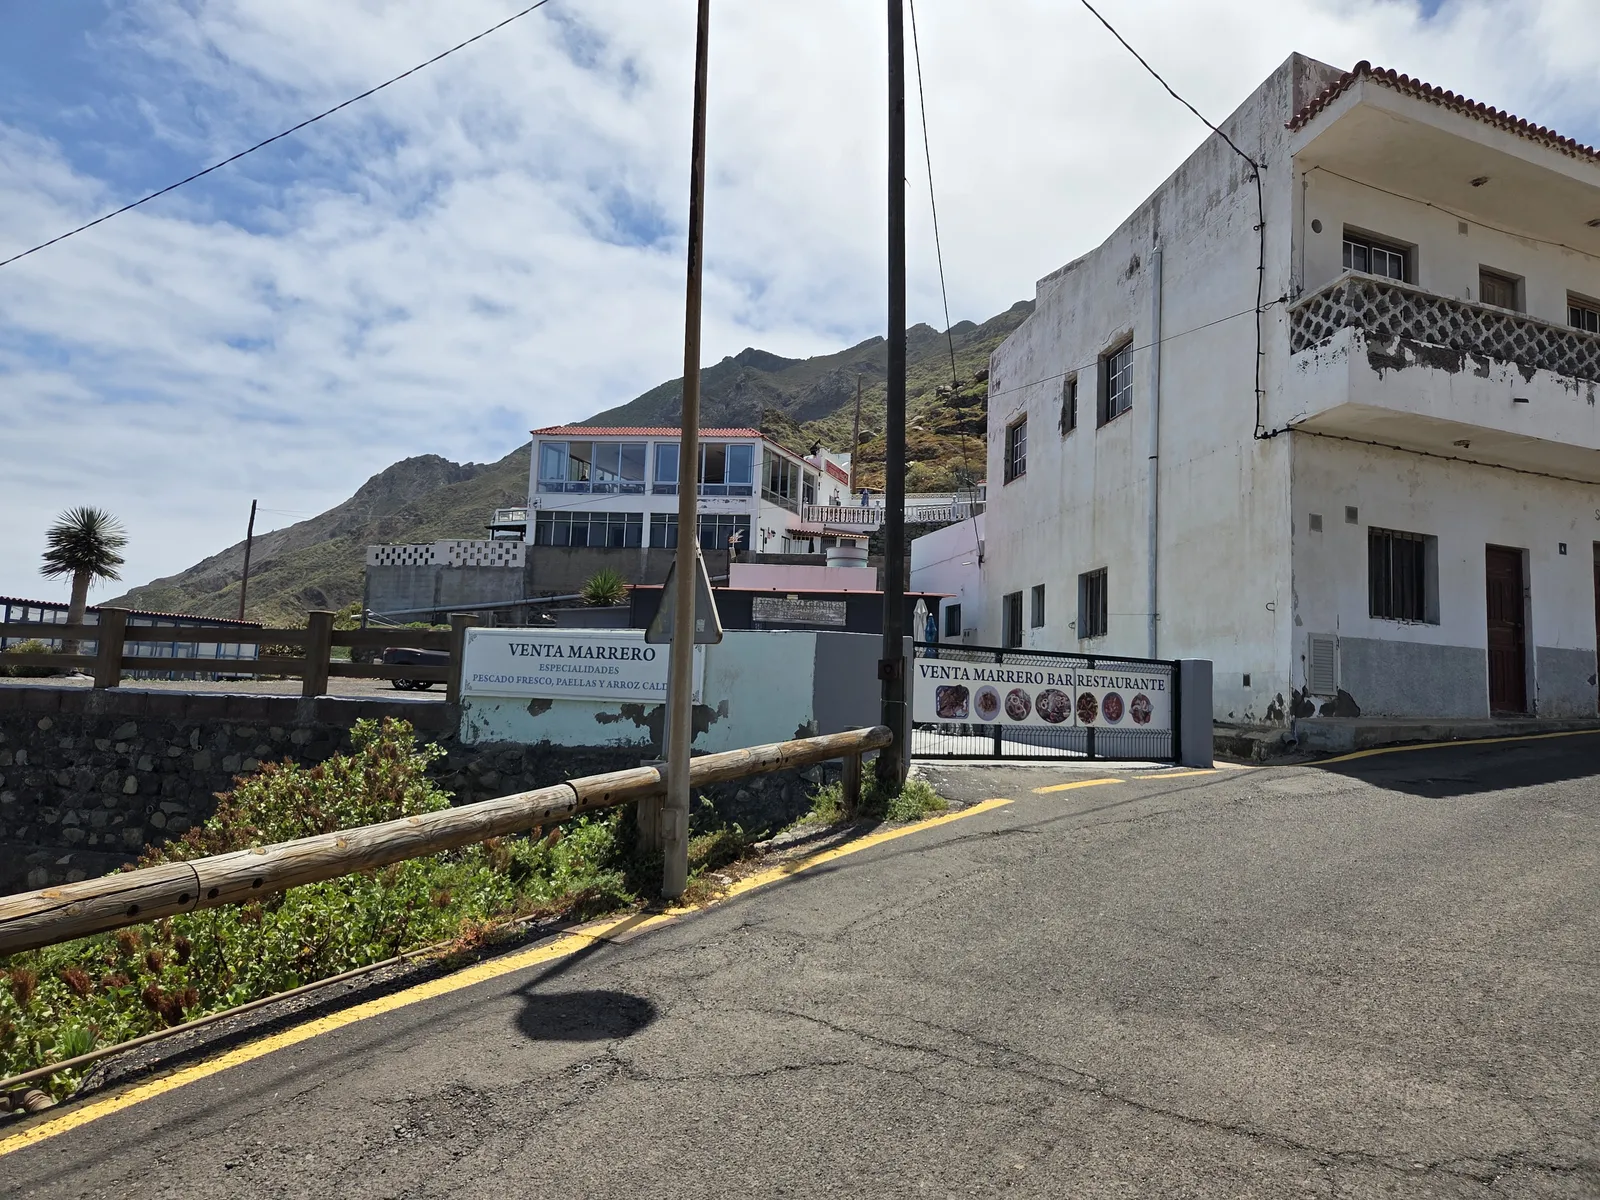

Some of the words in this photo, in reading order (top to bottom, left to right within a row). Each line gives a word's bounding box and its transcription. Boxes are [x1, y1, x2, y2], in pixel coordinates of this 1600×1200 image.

[508, 642, 564, 658] VENTA
[567, 645, 656, 661] MARRERO
[539, 663, 620, 675] ESPECIALIDADES
[920, 664, 970, 681] VENTA
[973, 668, 1044, 685] MARRERO
[1047, 673, 1074, 686] BAR
[1076, 677, 1166, 691] RESTAURANTE
[473, 673, 515, 684] PESCADO
[516, 676, 554, 687] FRESCO,
[556, 677, 597, 688] PAELLAS
[598, 679, 605, 688] Y
[606, 680, 640, 690] ARROZ
[642, 681, 668, 691] CALD
